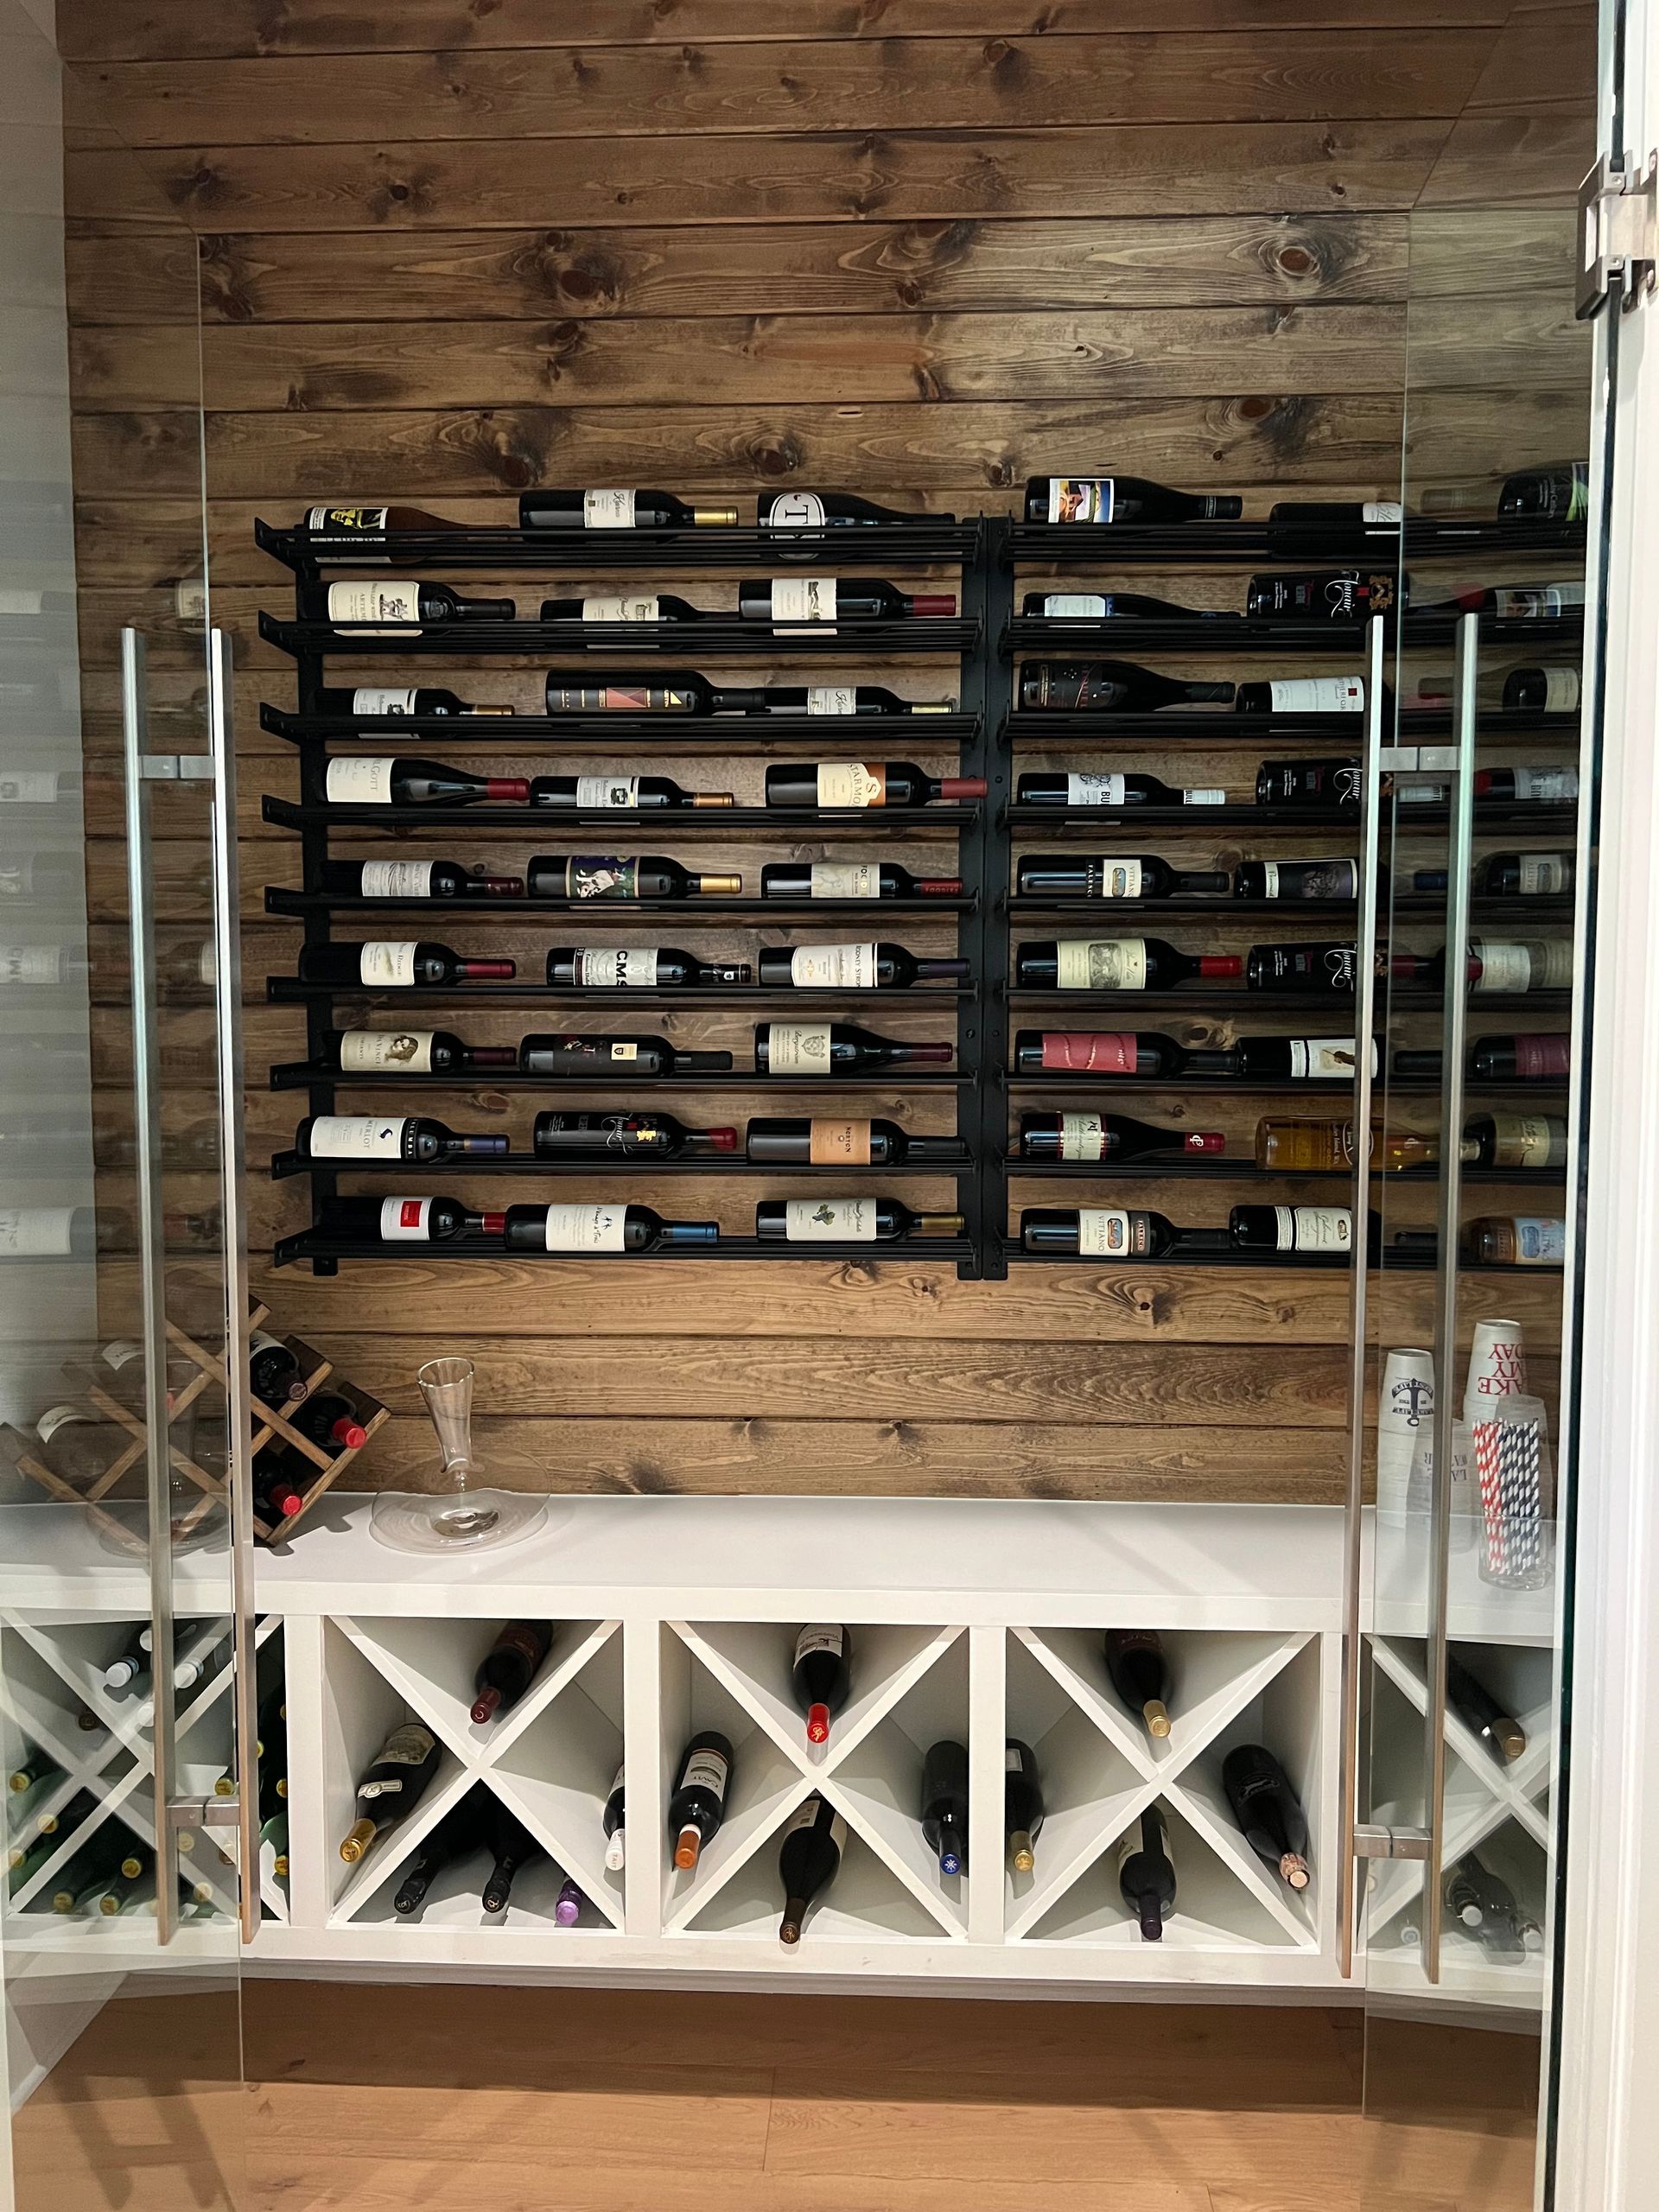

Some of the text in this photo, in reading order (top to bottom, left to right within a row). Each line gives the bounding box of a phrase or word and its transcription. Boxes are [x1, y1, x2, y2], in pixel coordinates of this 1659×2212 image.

[848, 764, 862, 807] STARMO
[866, 782, 877, 793] S
[1100, 791, 1111, 804] BU
[615, 950, 628, 988] CMS
[854, 968, 863, 987] STRON
[363, 1119, 374, 1148] MERLOT
[1097, 1216, 1106, 1251] VITIANO
[1491, 1361, 1524, 1378] MY
[1478, 1377, 1522, 1395] AKE
